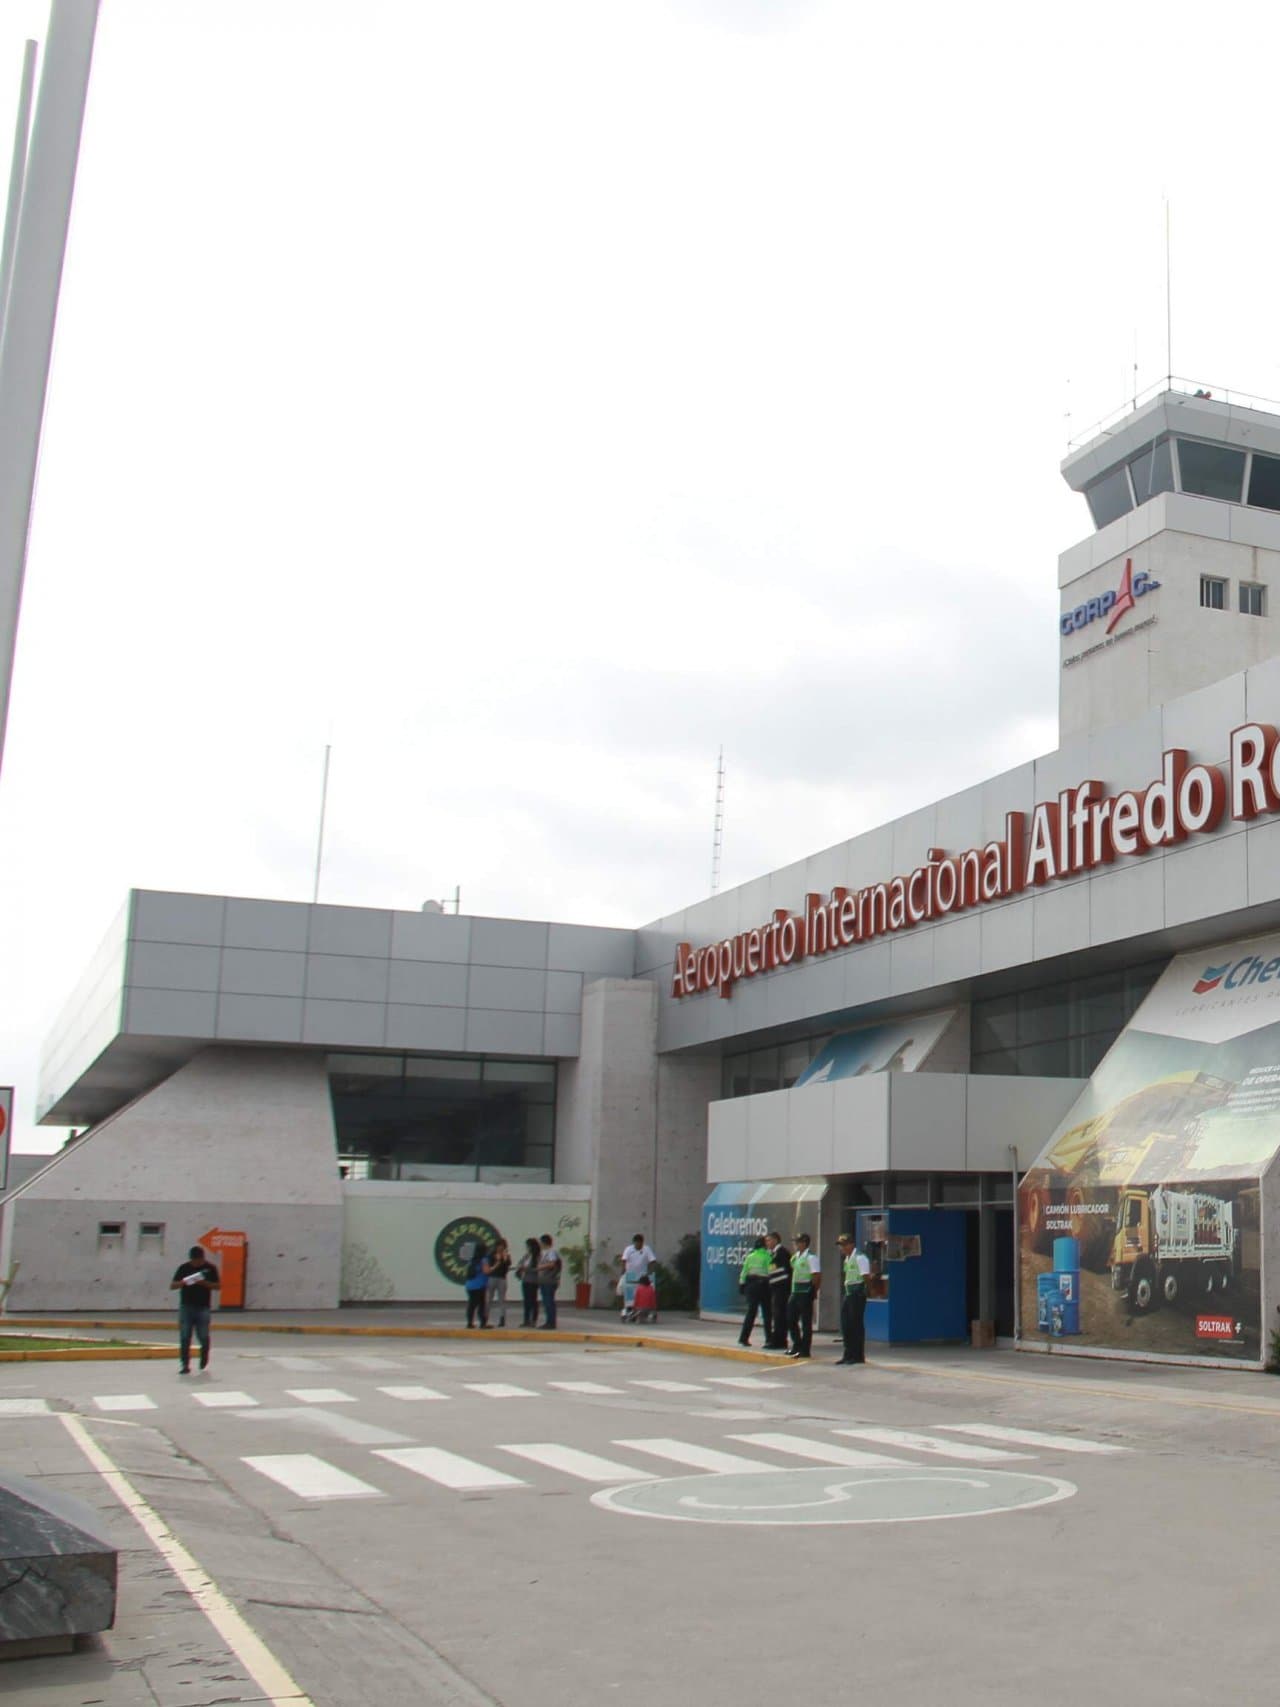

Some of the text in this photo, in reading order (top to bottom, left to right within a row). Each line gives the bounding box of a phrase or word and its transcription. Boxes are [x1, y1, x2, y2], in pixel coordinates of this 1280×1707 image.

[671, 909, 804, 998] Aeropuerto
[805, 812, 1024, 956] Internacional
[1024, 748, 1226, 887] Alfredo
[707, 1211, 769, 1236] Celebremos
[706, 1246, 725, 1271] que
[1198, 1319, 1233, 1333] SOLTRAK
